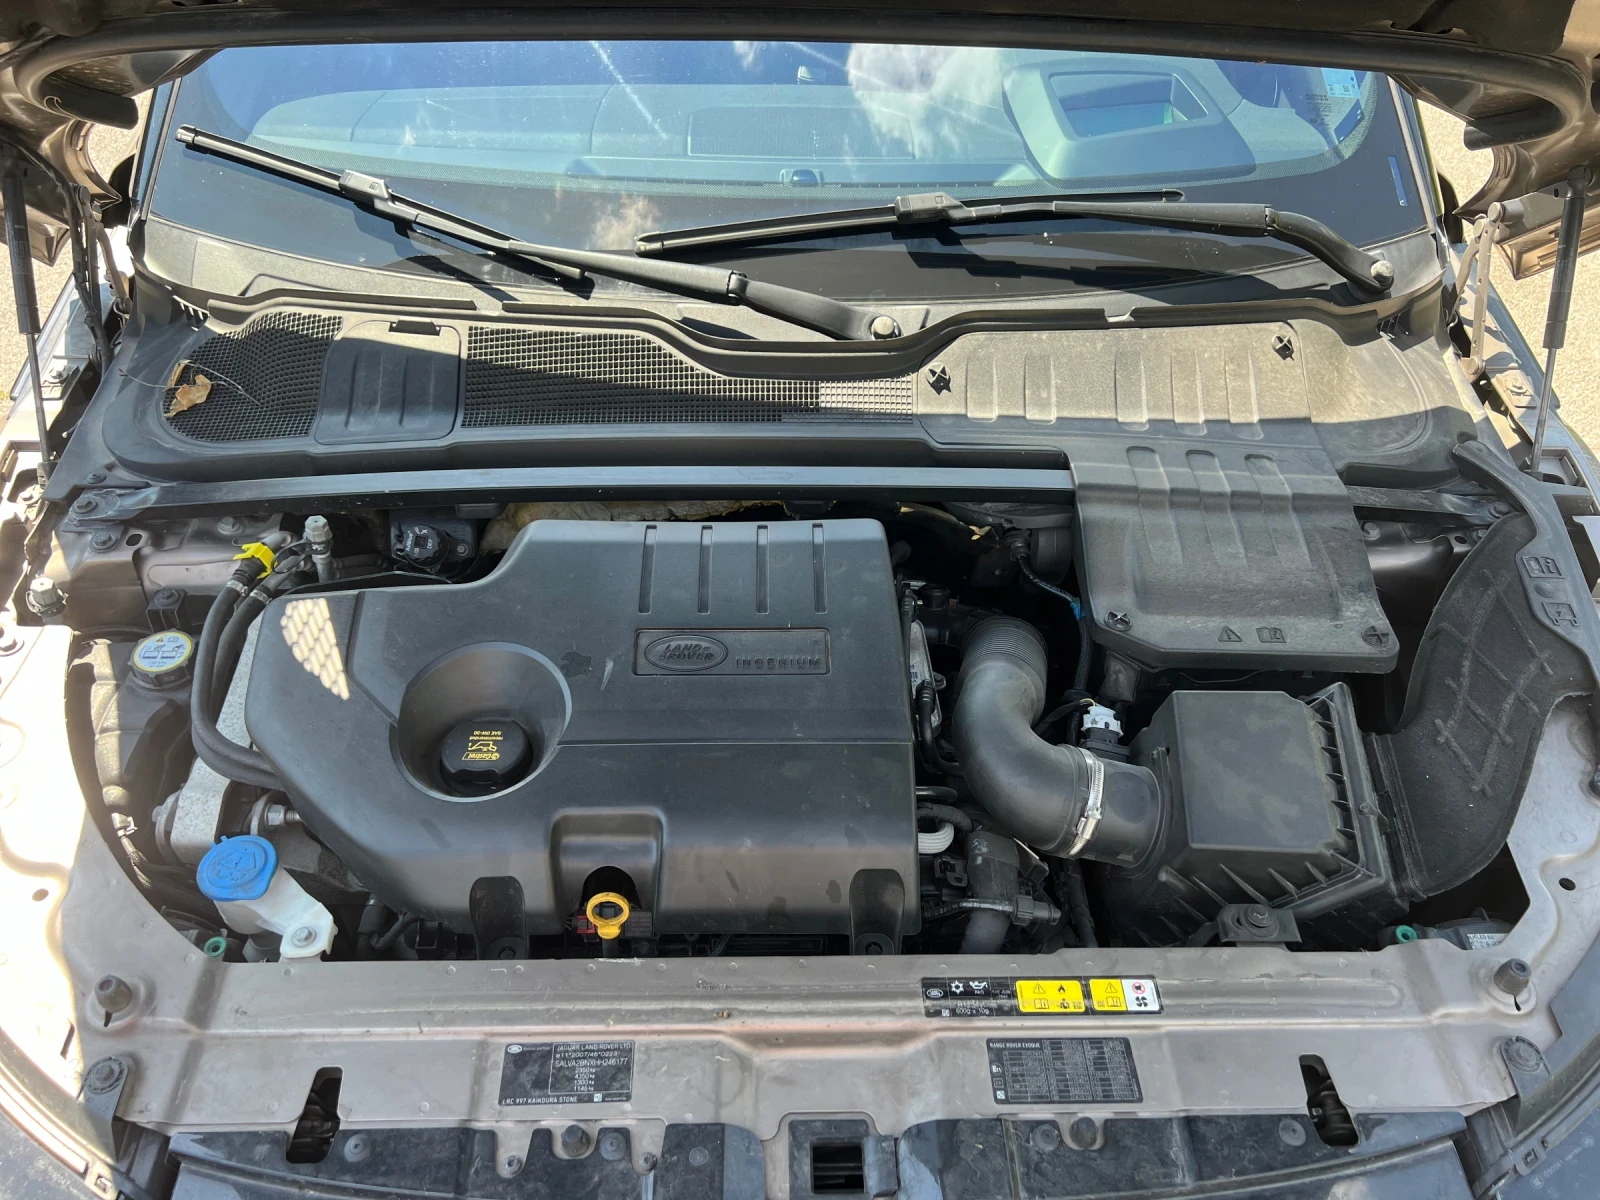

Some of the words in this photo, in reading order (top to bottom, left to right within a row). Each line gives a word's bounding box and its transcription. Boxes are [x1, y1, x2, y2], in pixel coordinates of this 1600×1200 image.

[666, 652, 715, 661] ROVER
[735, 656, 822, 670] INGENIUM
[556, 1044, 580, 1052] JAGUAR
[581, 1043, 599, 1051] LAND
[599, 1042, 619, 1050] ROVER
[502, 1097, 515, 1105] LRC
[527, 1096, 558, 1104] KAIKOURA
[558, 1095, 578, 1103] STONE
